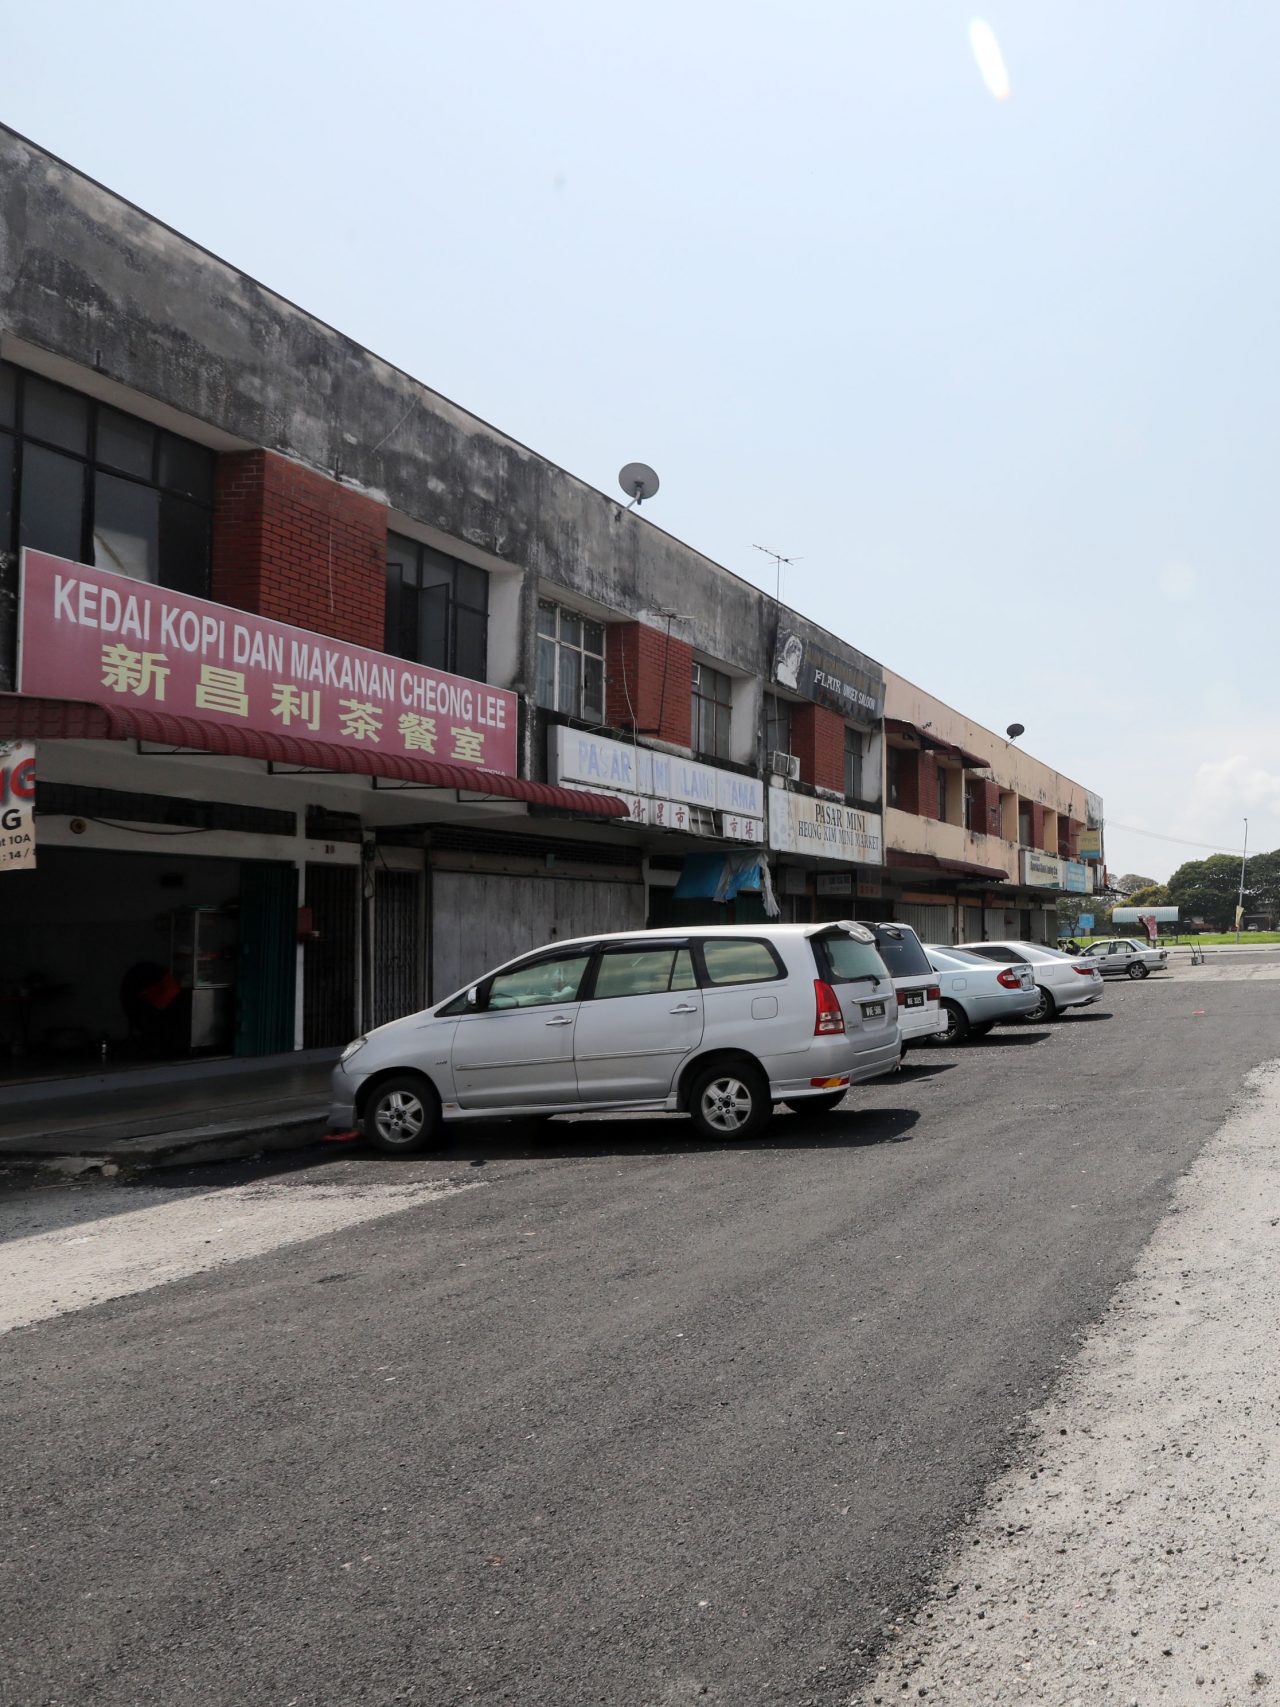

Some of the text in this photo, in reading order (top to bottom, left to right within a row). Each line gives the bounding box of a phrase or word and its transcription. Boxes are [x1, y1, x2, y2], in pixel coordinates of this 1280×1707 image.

[54, 574, 506, 729] KEDAI KOPI DAN MAKANAN CHEONG LEE
[101, 643, 485, 764] 新昌利茶餐室
[814, 669, 842, 694] FLAIR
[858, 692, 876, 710] SALOON
[578, 740, 632, 784] PASAR
[674, 766, 714, 801] LANG
[798, 820, 879, 850] HEONG KIM MINI MARKET
[815, 804, 866, 833] PASAR MINI
[9, 834, 31, 845] 10A
